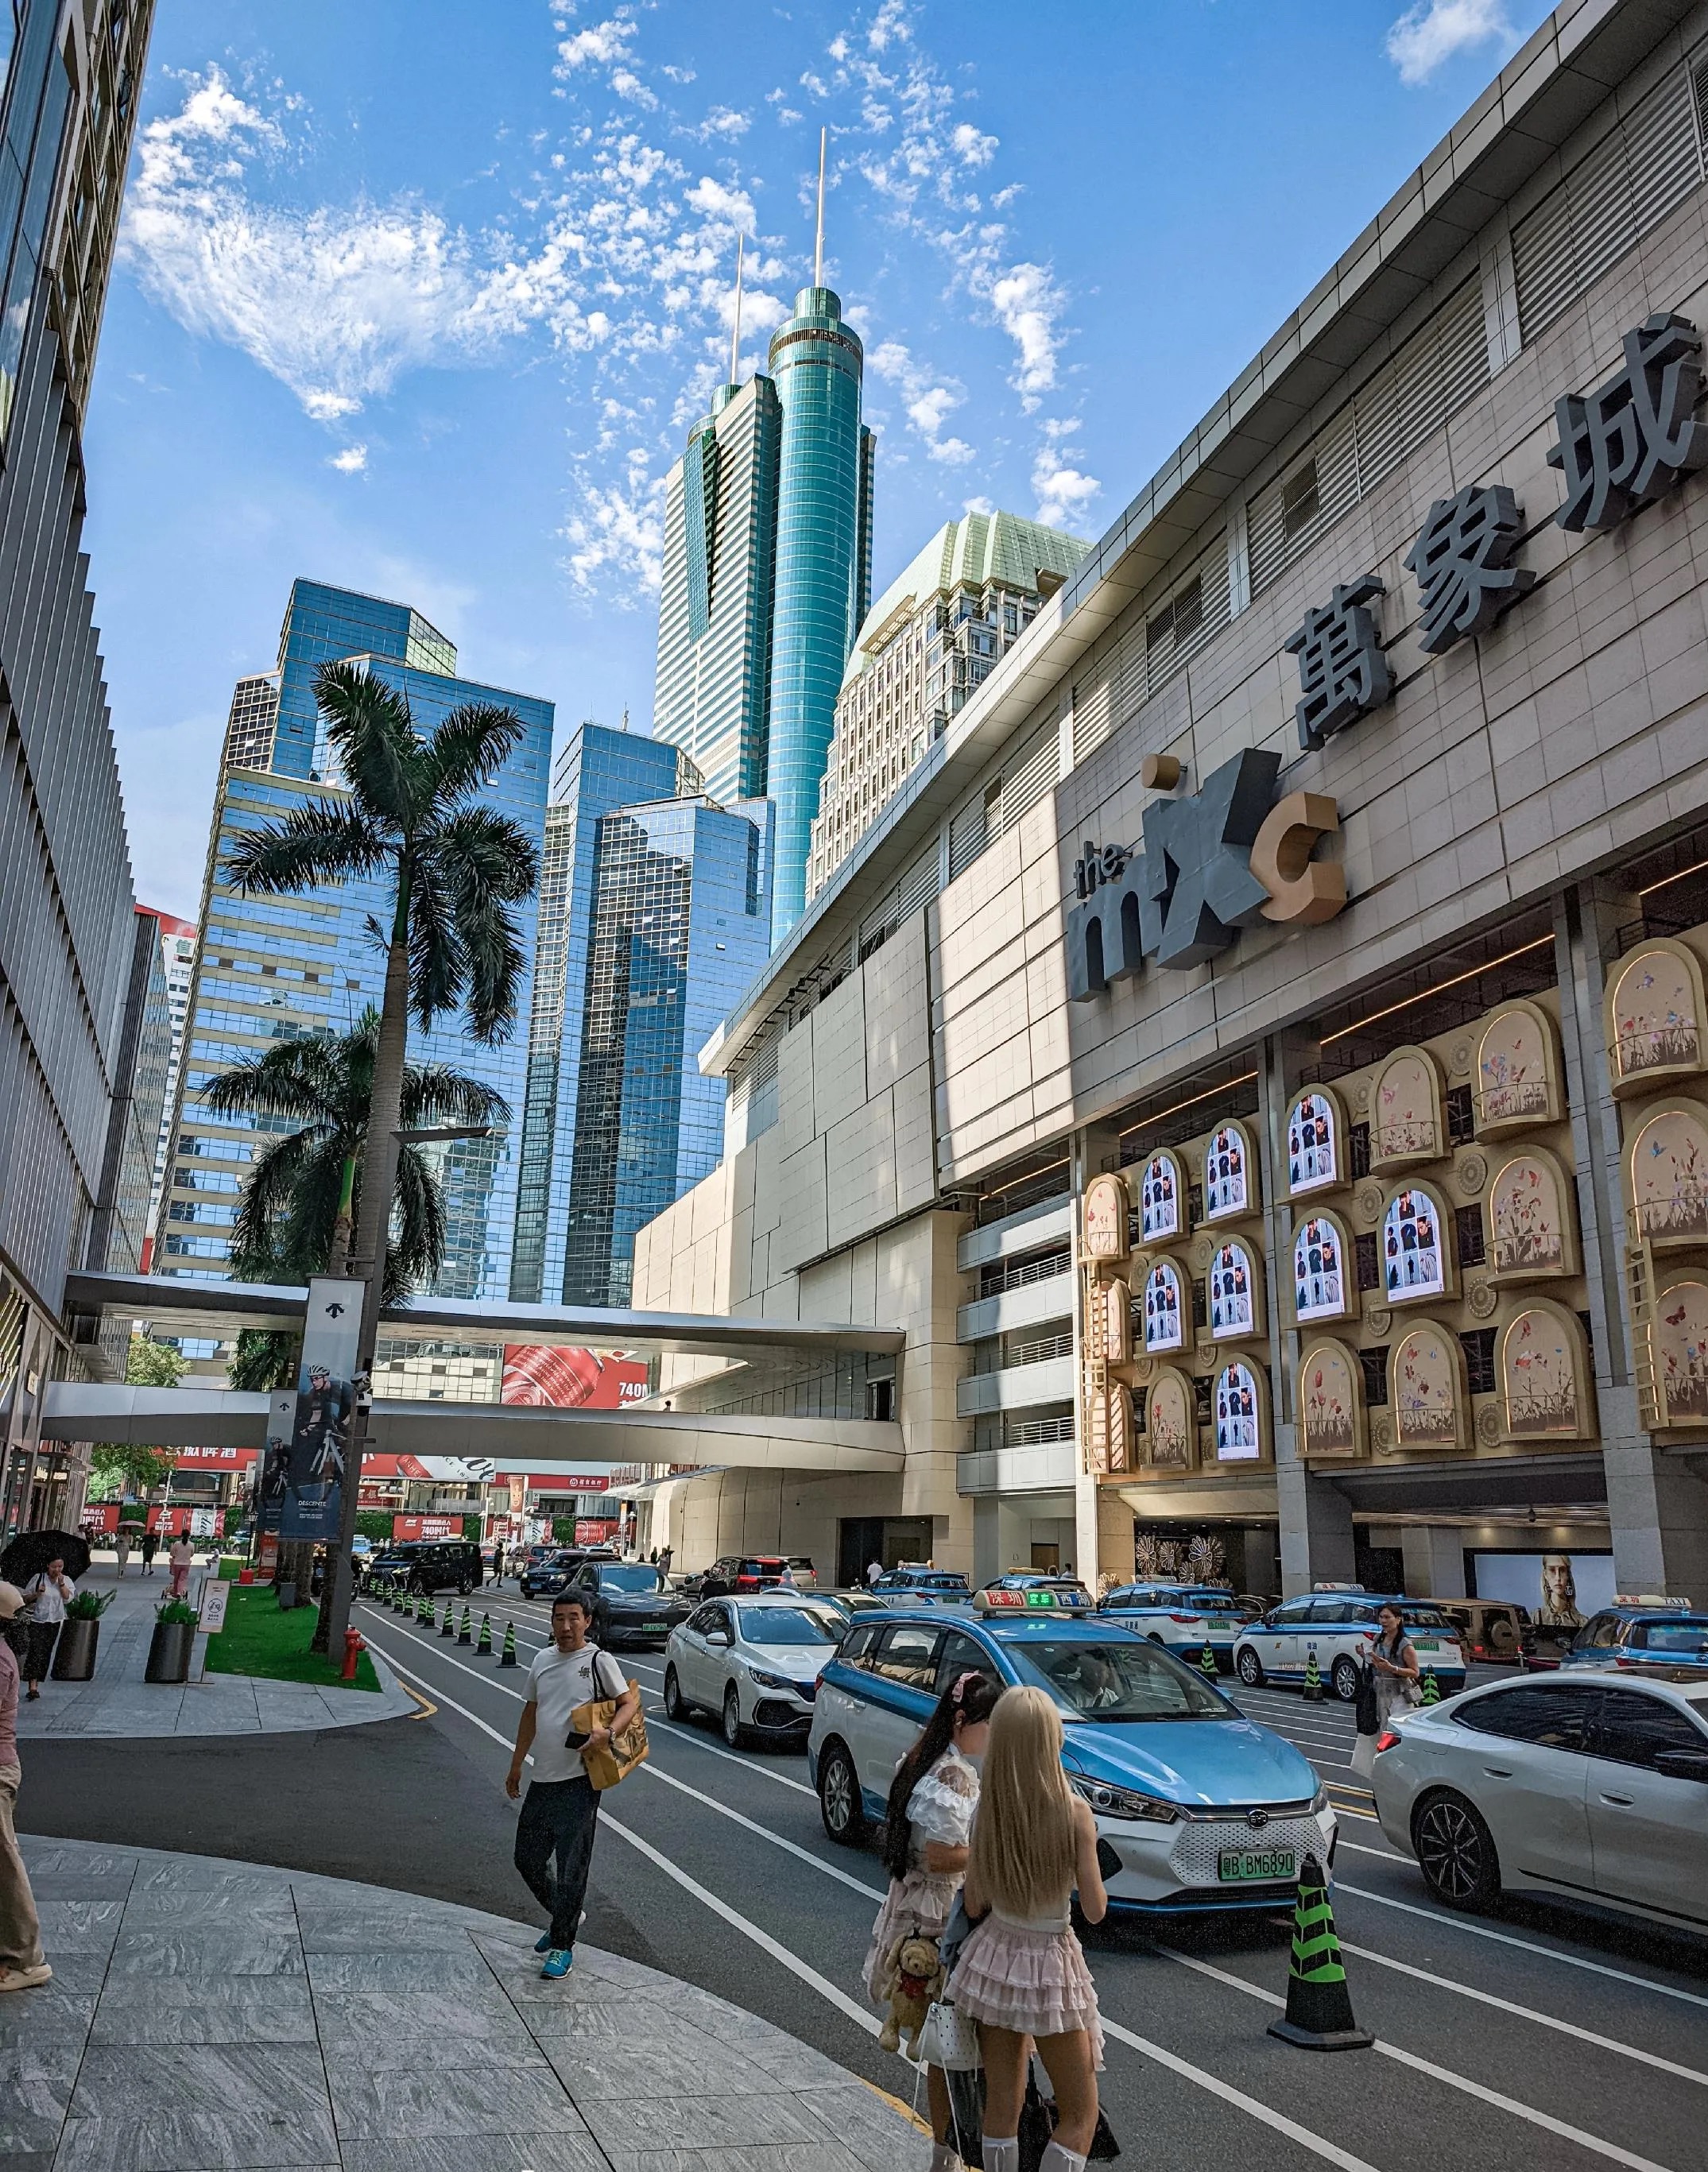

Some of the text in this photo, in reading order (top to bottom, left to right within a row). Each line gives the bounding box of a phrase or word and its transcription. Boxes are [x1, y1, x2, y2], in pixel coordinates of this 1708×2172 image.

[1284, 312, 1708, 751] 萬象城
[1074, 841, 1125, 899] the
[990, 1592, 1090, 1606] 深圳 空车 西湖
